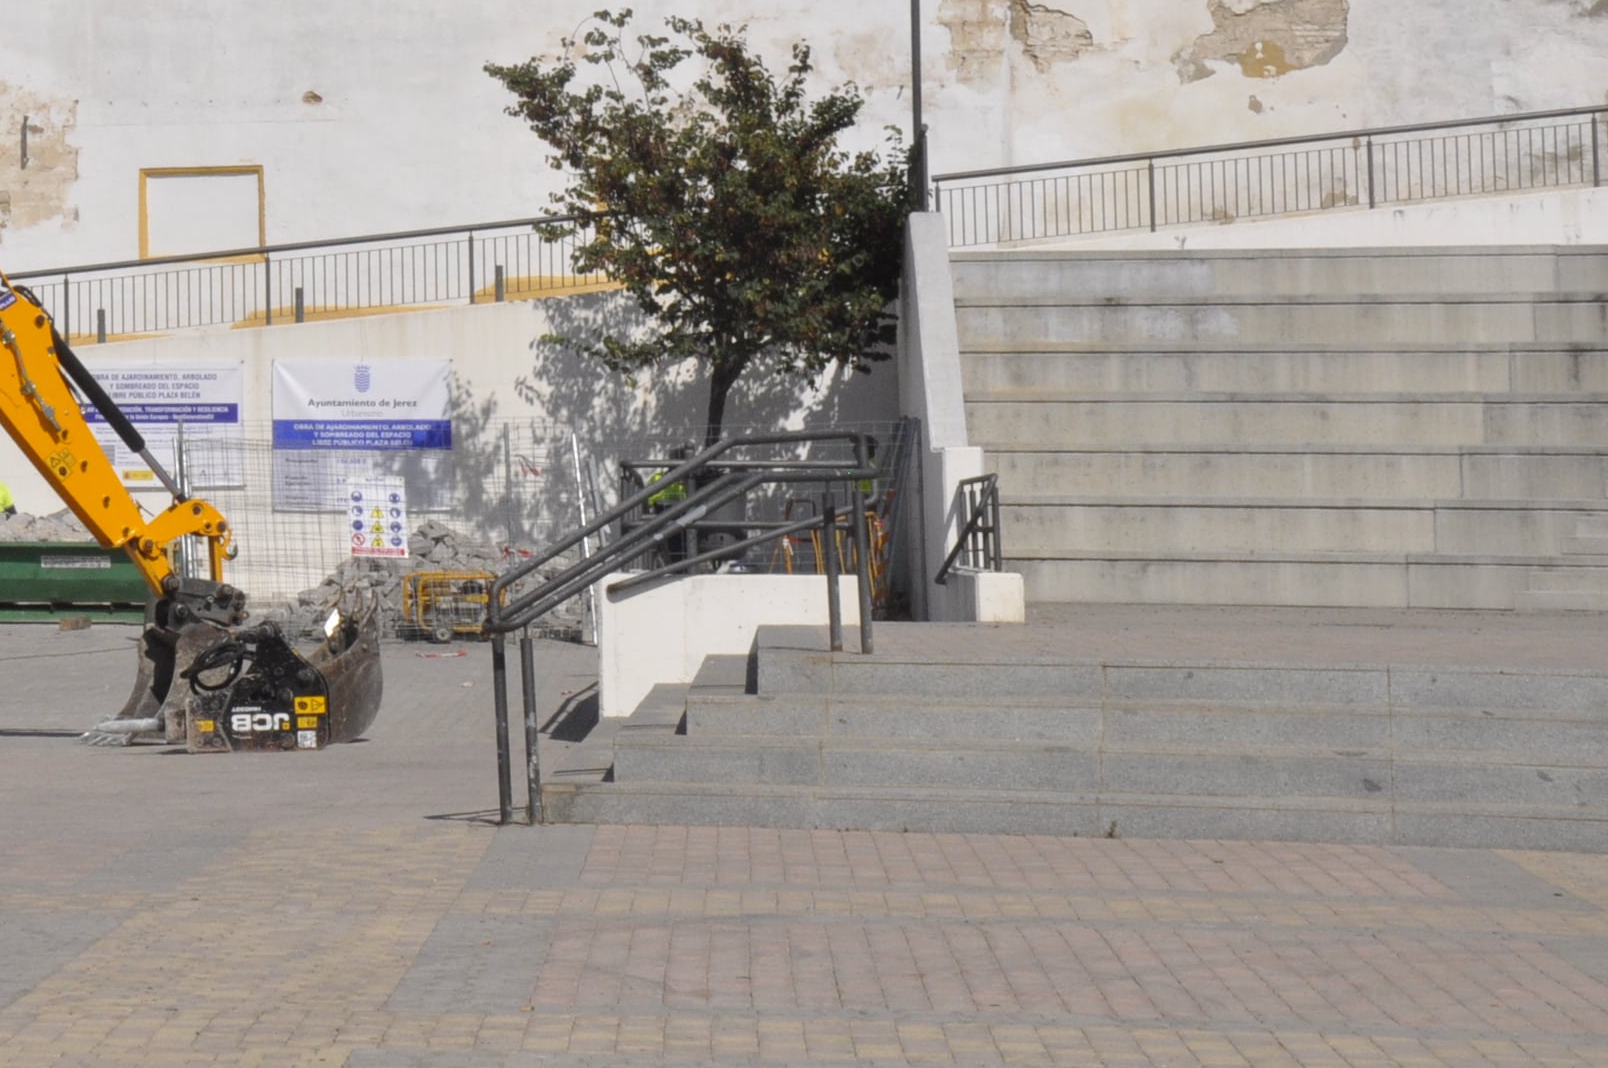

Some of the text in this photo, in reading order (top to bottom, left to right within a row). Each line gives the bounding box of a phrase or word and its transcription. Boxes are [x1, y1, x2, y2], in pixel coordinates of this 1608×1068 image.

[111, 373, 119, 381] DE
[182, 373, 217, 381] ARBOLADO
[128, 390, 157, 399] PÚBLICO
[180, 390, 200, 399] BELÉN
[307, 398, 417, 409] Ayuntamiento de Jerez
[231, 712, 290, 732] JCB
